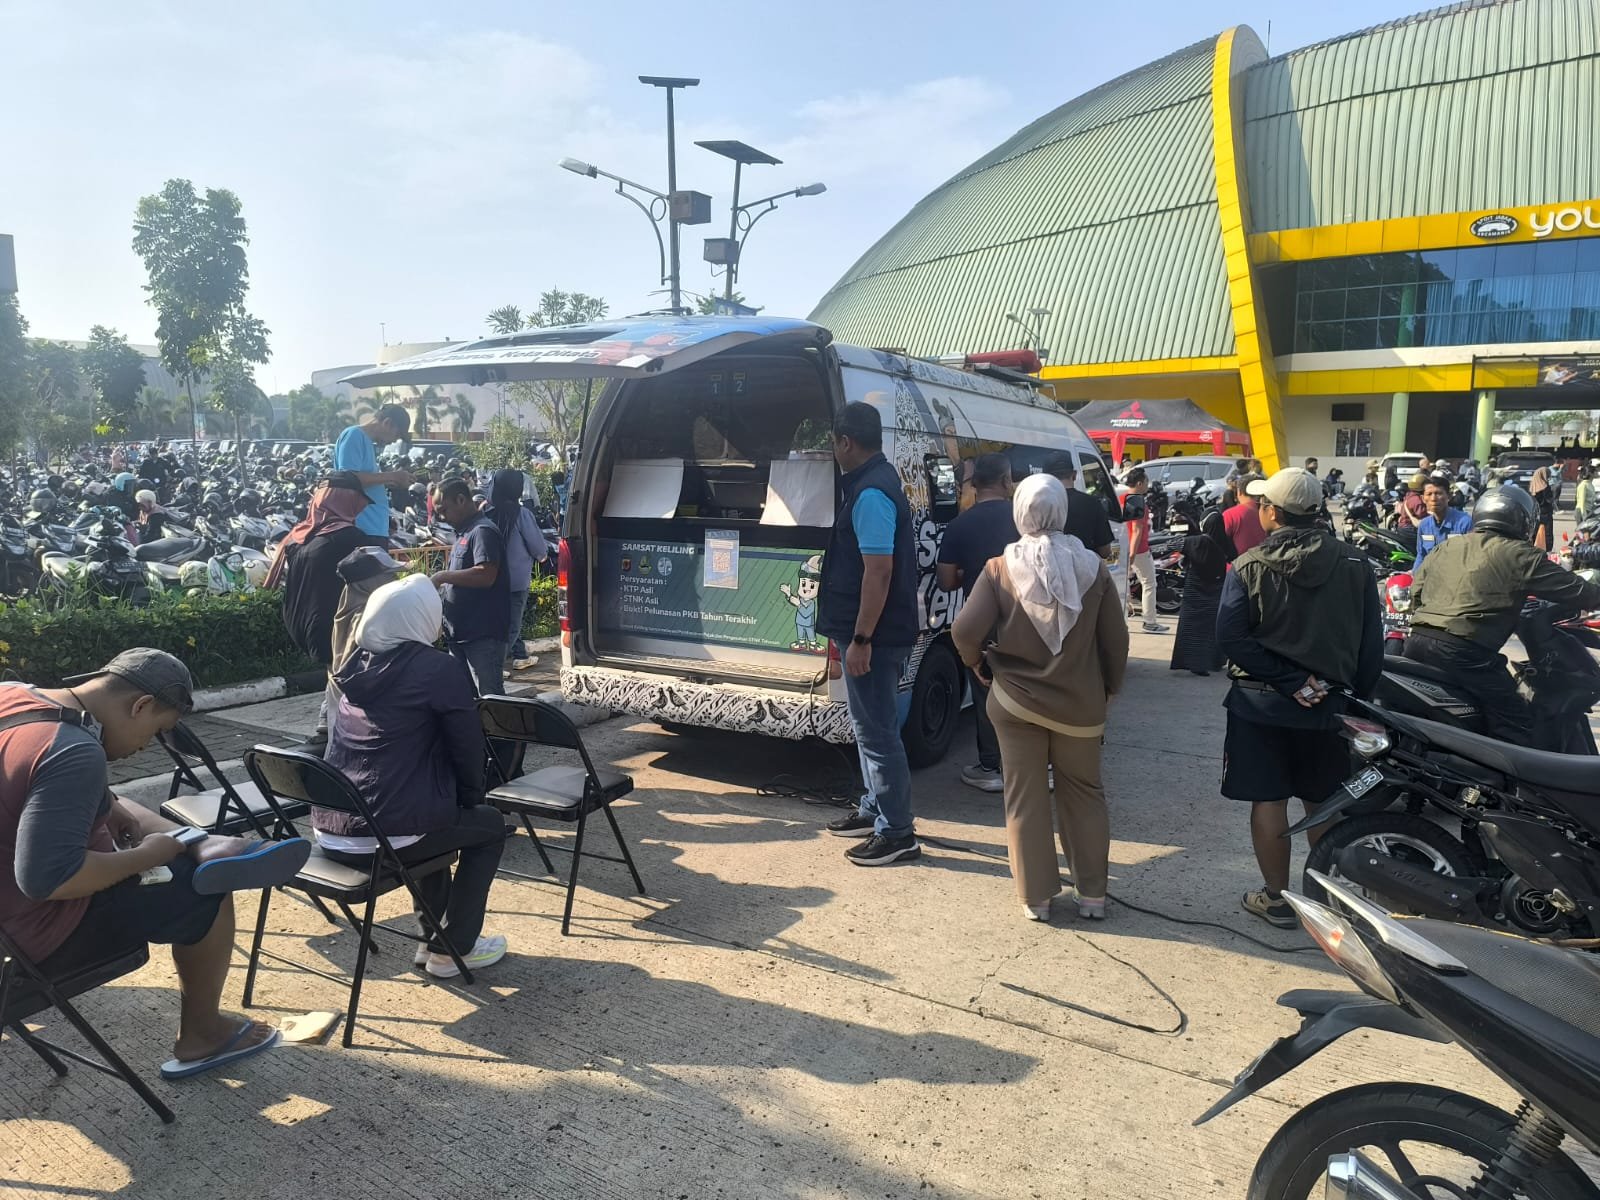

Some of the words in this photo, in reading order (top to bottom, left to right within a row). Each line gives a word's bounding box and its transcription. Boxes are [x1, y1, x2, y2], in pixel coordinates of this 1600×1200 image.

[621, 543, 656, 552] SAMSAT
[656, 544, 695, 555] KELILING
[623, 585, 639, 593] KTP
[623, 594, 643, 603] STNK
[644, 606, 681, 617] Pelunasan
[682, 610, 698, 619] PKB
[700, 611, 724, 622] Tahun
[724, 614, 757, 625] Terakhir
